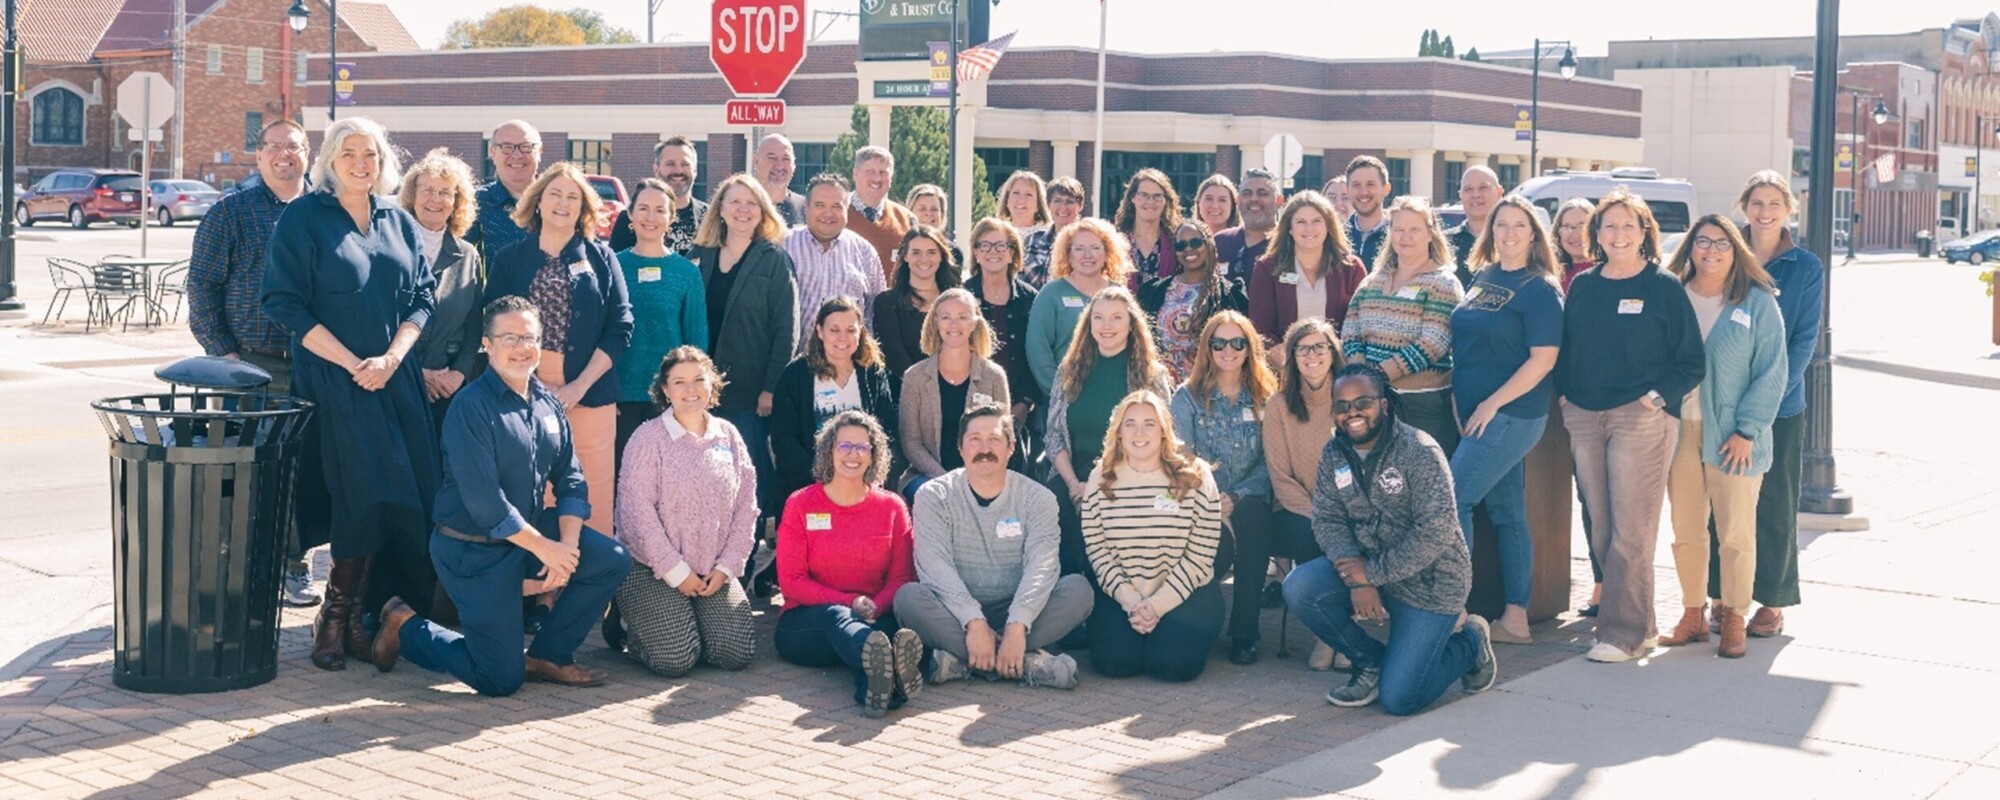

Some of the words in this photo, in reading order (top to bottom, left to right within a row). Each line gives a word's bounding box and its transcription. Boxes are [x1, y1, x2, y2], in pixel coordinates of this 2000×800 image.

[890, 3, 898, 16] &
[901, 2, 936, 16] TRUST
[718, 4, 800, 54] STOP
[886, 85, 894, 94] 24
[897, 84, 919, 93] HOUR
[730, 105, 752, 121] ALL
[757, 105, 780, 121] WAY
